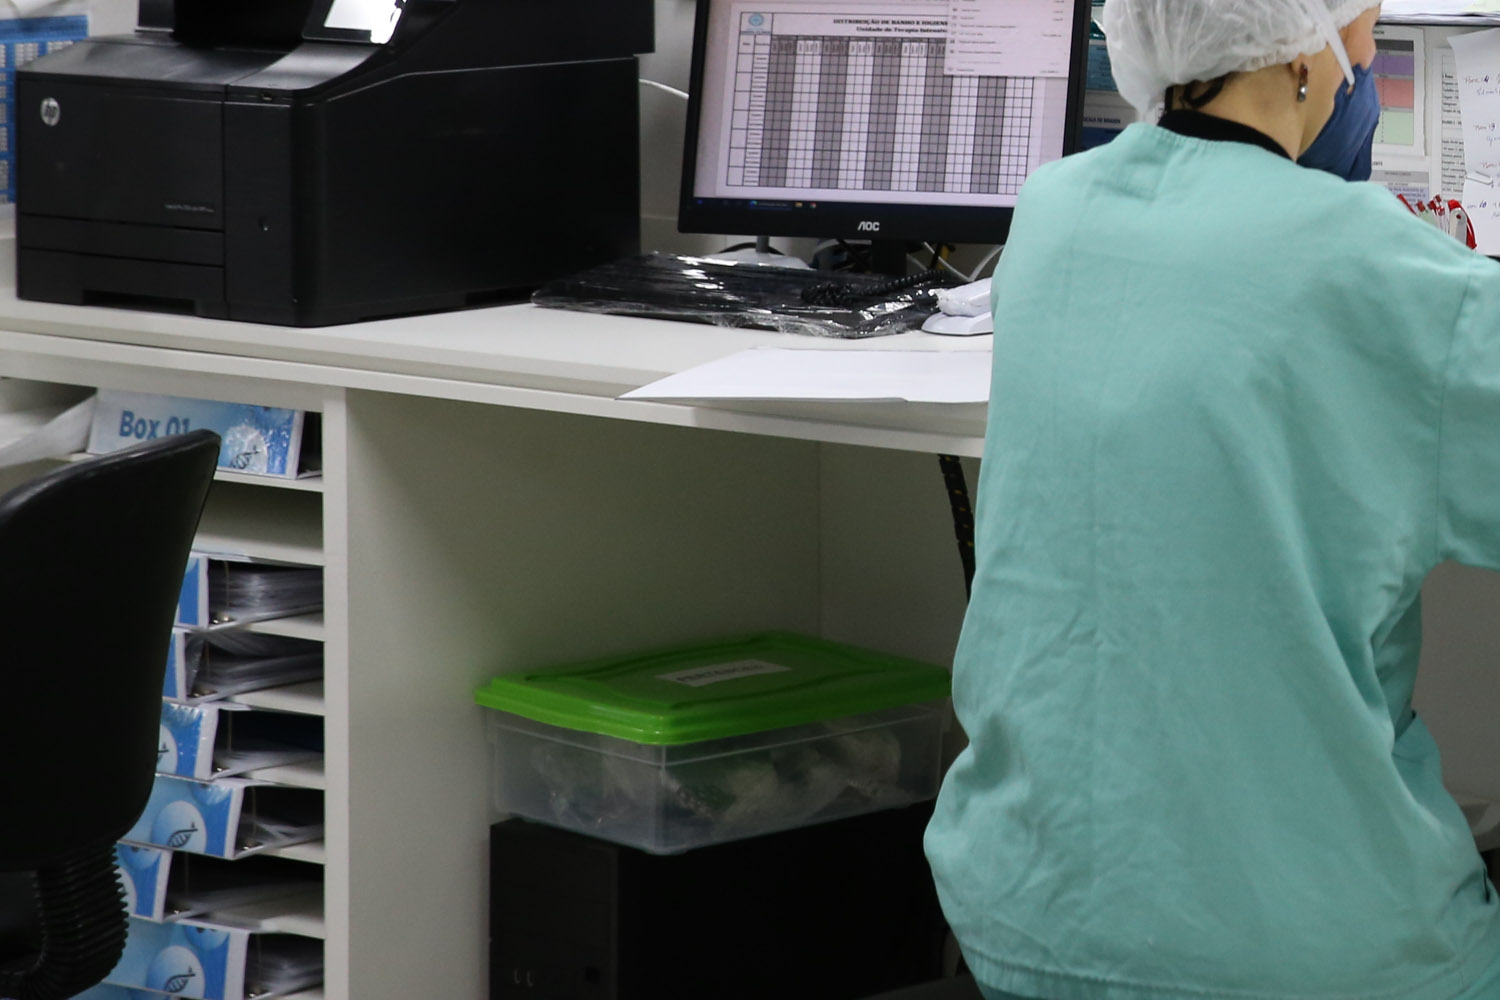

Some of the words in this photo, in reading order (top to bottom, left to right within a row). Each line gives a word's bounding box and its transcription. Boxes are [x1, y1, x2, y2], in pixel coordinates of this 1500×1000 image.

[857, 220, 880, 231] AOC
[119, 409, 160, 440] Box
[166, 415, 191, 436] 01
